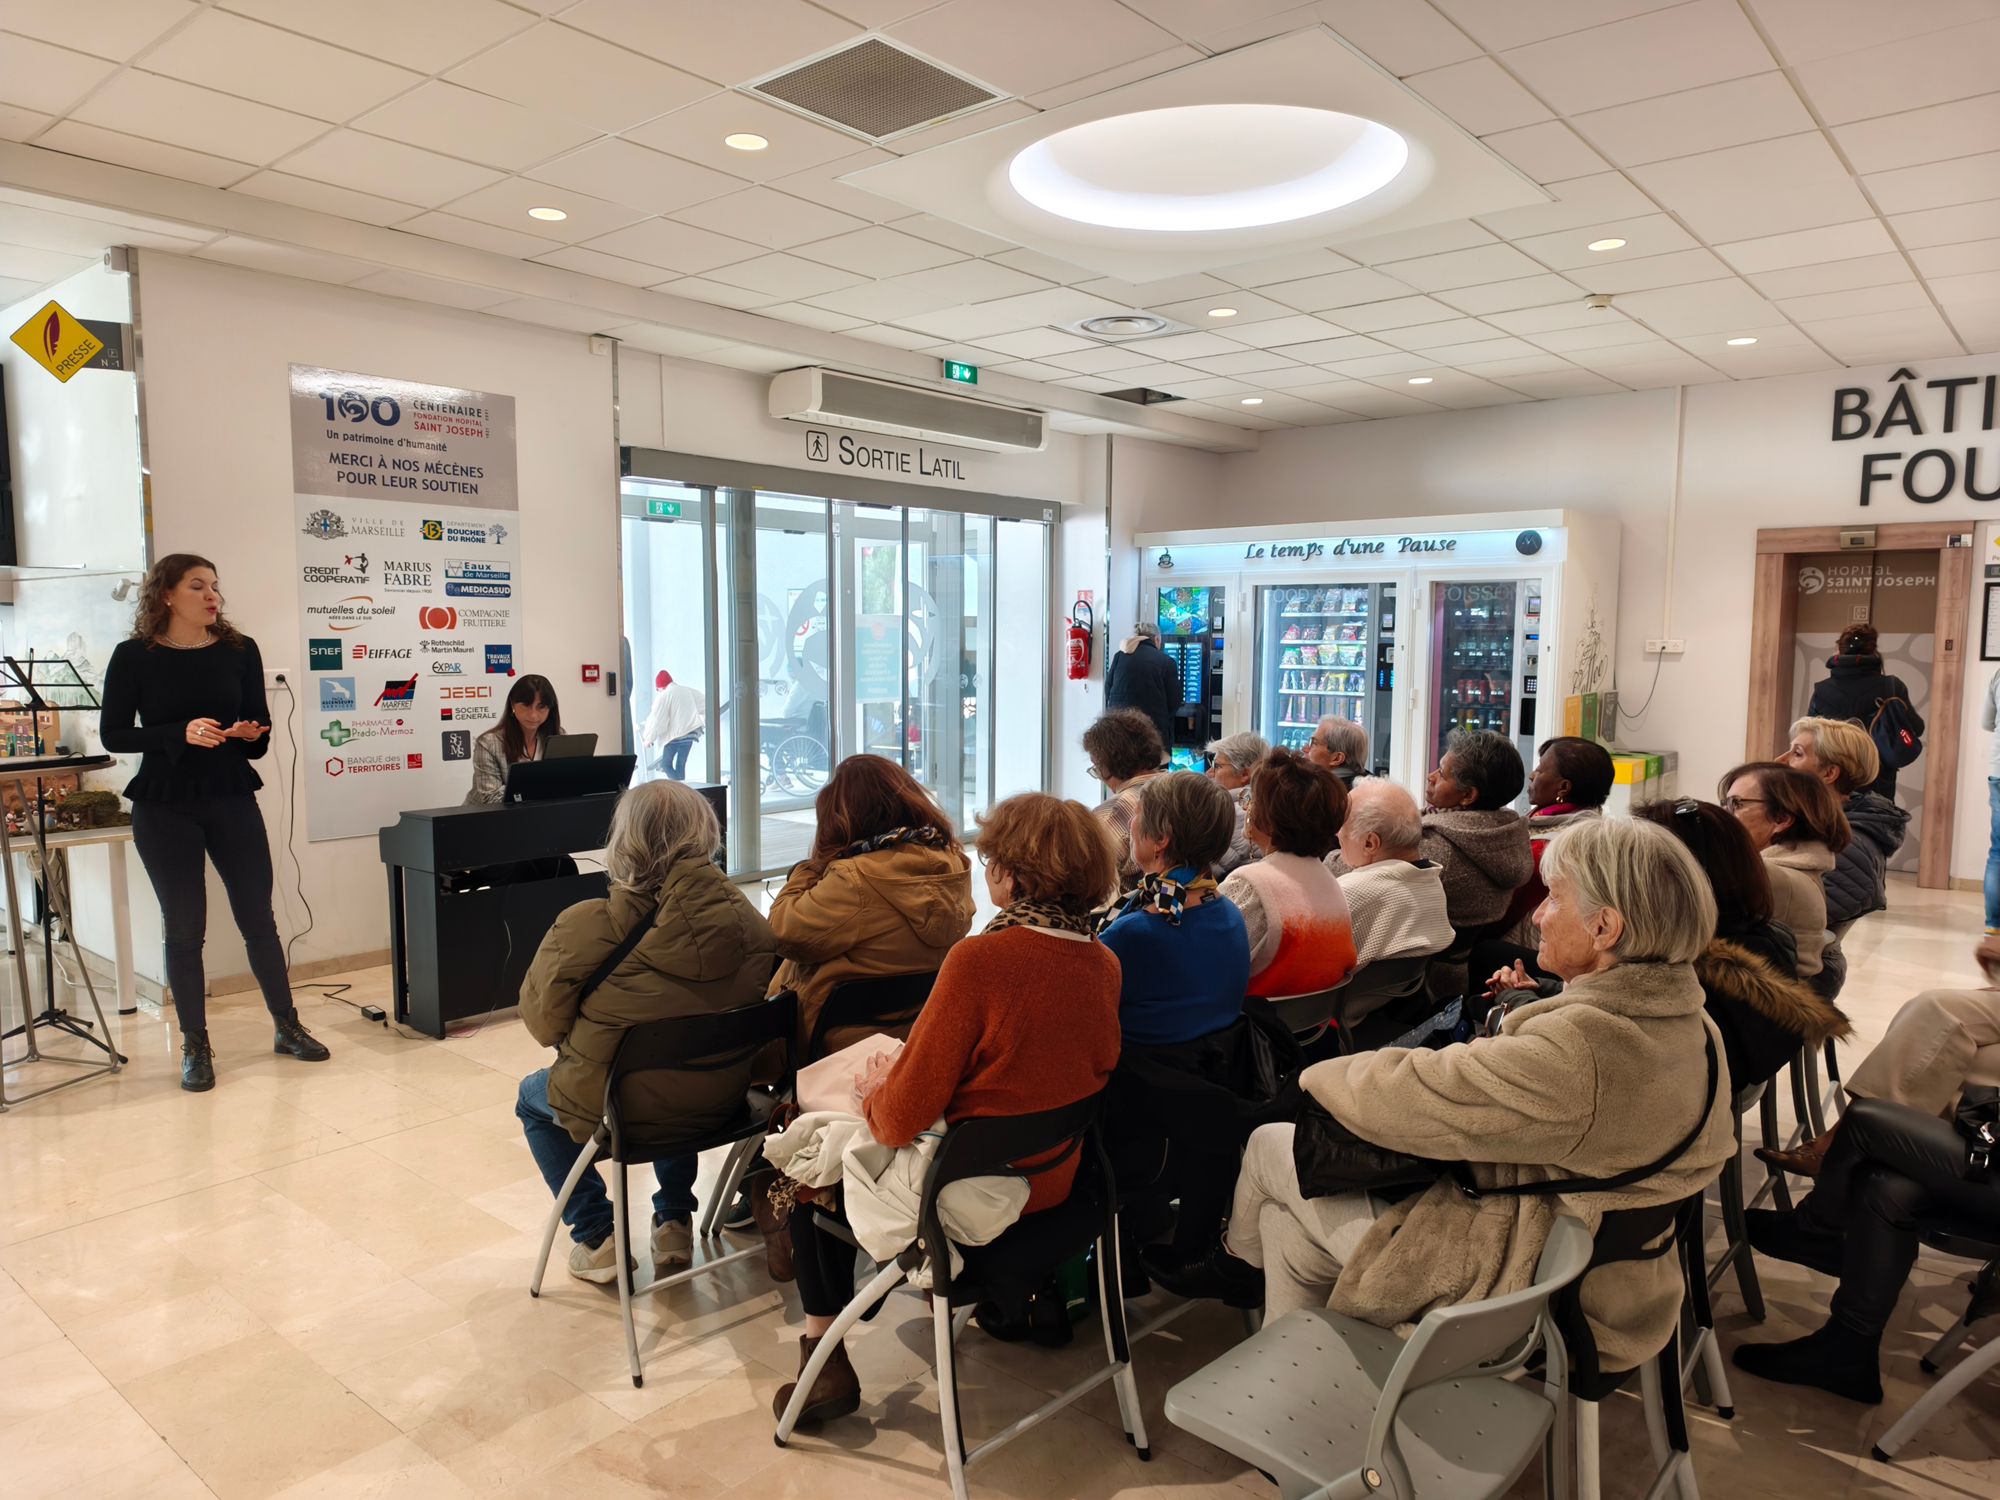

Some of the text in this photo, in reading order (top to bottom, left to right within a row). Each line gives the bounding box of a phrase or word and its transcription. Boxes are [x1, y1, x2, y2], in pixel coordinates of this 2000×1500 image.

[56, 339, 96, 376] PRESSE
[101, 360, 109, 368] N
[413, 400, 482, 418] CENTENAIRE
[413, 412, 453, 423] FONDATION
[414, 421, 442, 433] SAINT
[446, 425, 483, 438] JOSEPH
[326, 430, 447, 452] Un patrimoine d'humanité
[839, 436, 966, 480] SORTIE LATIL
[329, 452, 484, 479] MERCI À NOS MÉCÈNES
[1860, 447, 2000, 507] FOU
[337, 471, 478, 494] POUR LEUR SOUTIEN
[352, 517, 383, 525] VILLE
[351, 526, 406, 537] MARSEILLE
[1244, 537, 1457, 561] Le temps d'une Pause
[303, 566, 340, 575] CREDIT
[384, 560, 432, 572] MARIUS
[464, 562, 491, 570] Eaux
[303, 575, 370, 584] COOPERATIF
[384, 572, 432, 586] FABRE
[460, 585, 511, 594] MEDICASUD
[307, 605, 396, 615] mutuelles du soleil
[458, 609, 510, 618] COMPAGNIE
[463, 619, 506, 627] FRUITIERE
[368, 649, 412, 659] EIFFAGE
[381, 700, 413, 708] MARFRET
[455, 706, 489, 714] SOCIETE
[455, 712, 497, 720] GENERALE
[351, 719, 393, 727] PHARMACIE
[351, 727, 414, 737] Prado-Mermoz
[347, 755, 383, 765] BANQUE
[347, 763, 401, 774] TERRITOIRES
